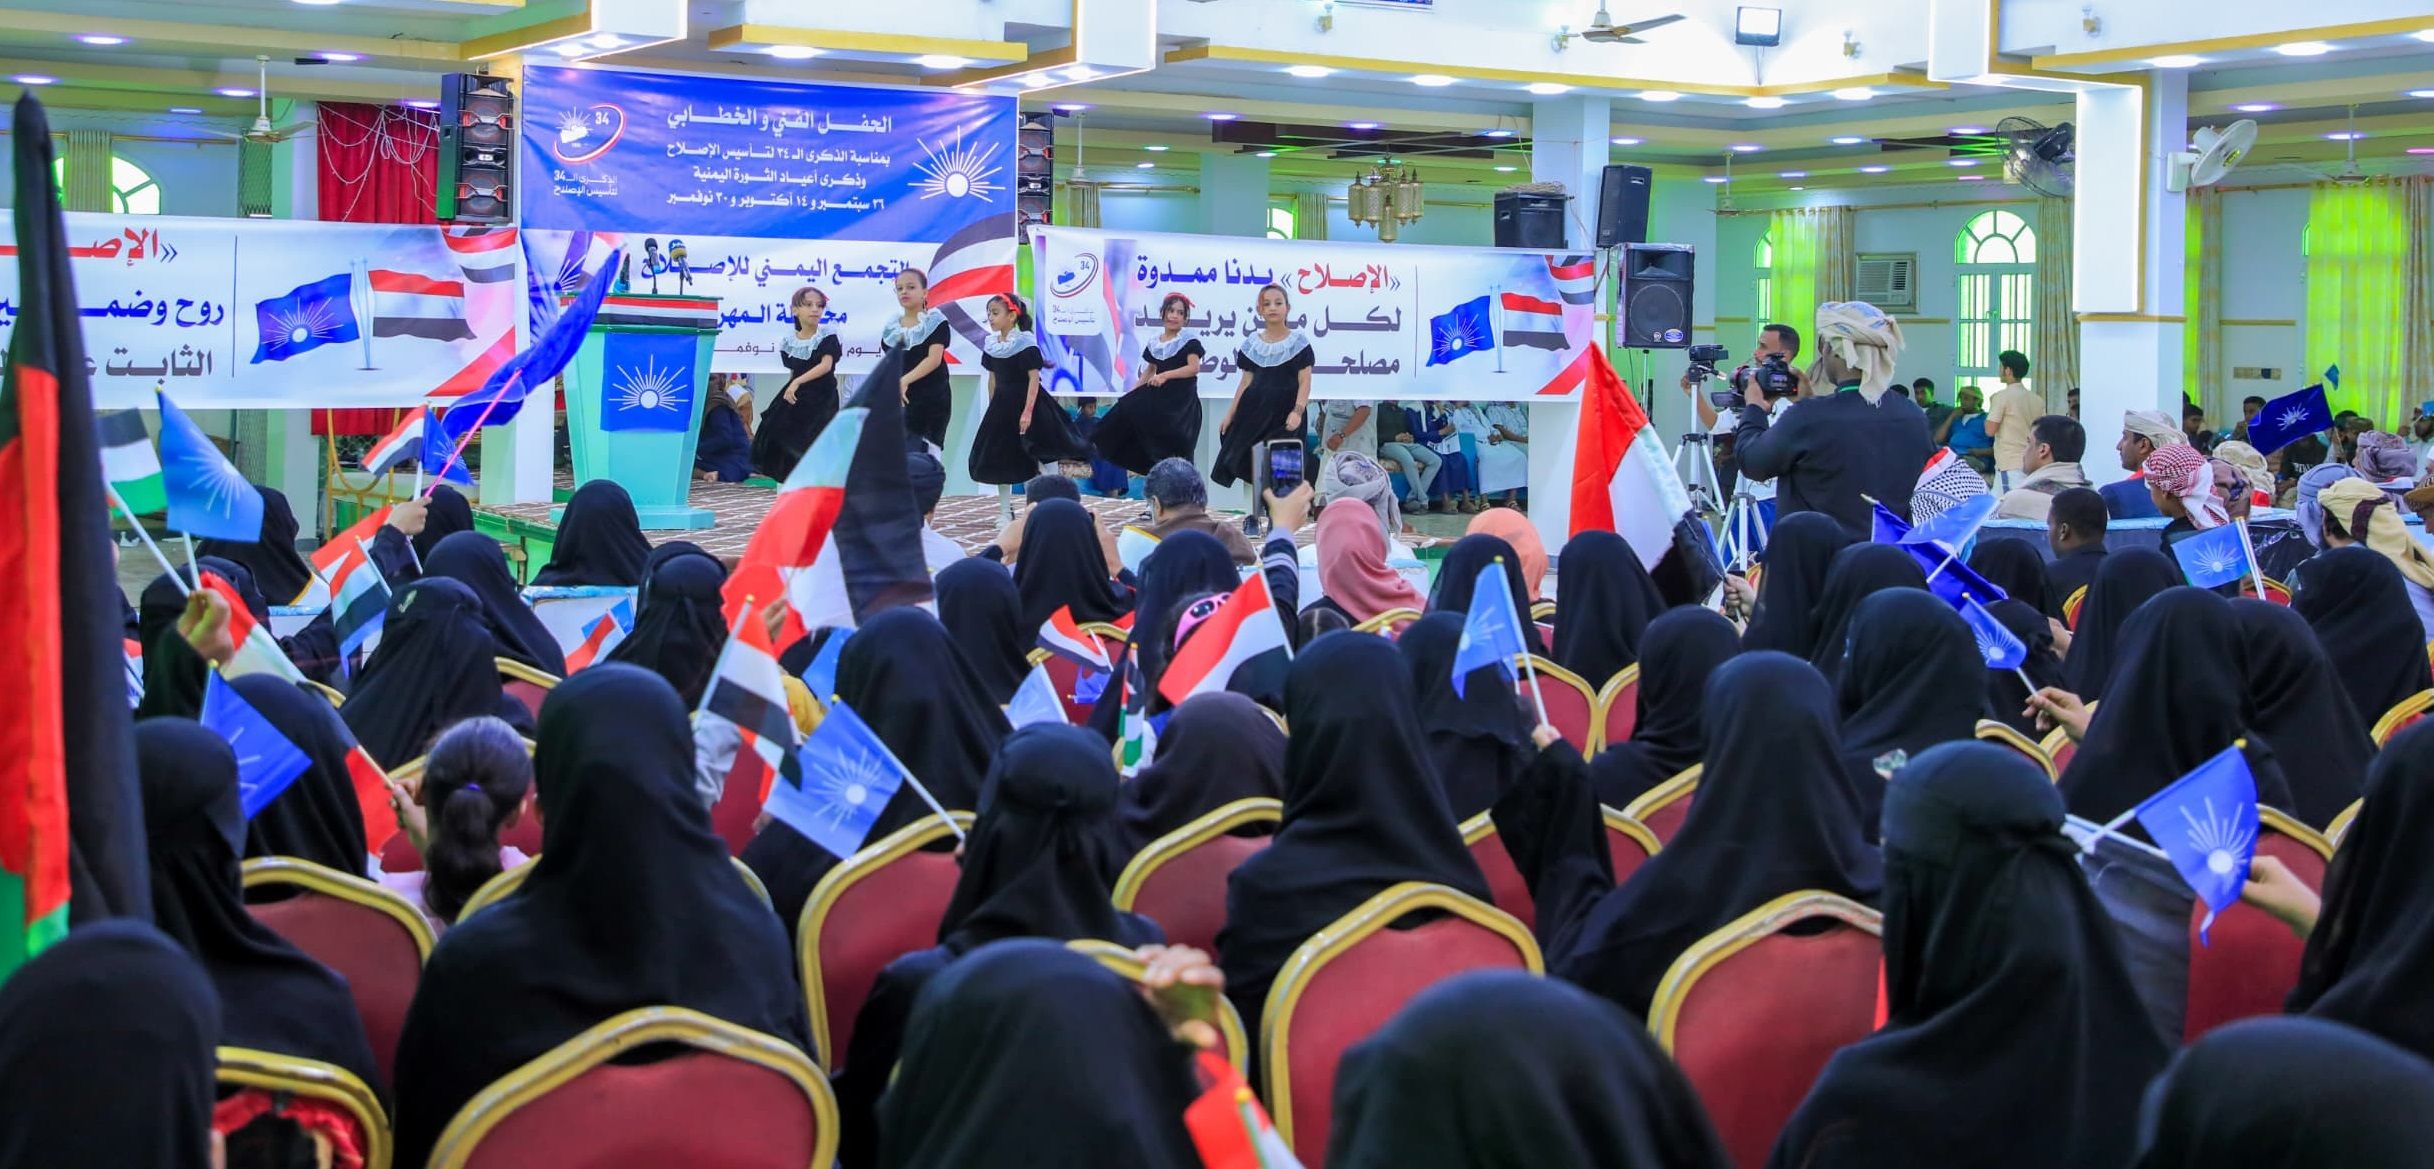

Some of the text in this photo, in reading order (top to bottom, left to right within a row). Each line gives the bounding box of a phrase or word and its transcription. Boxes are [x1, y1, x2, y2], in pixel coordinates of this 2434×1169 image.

[595, 111, 609, 125] 34
[667, 104, 892, 137] الحفل الفني و الخطابي
[666, 141, 720, 158] الإصلاح
[722, 143, 775, 160] لتأسيس
[806, 148, 848, 164] الذكرى
[849, 149, 891, 167] بمناسبة
[693, 165, 867, 189] وذكرى أعياد الثورة اليمنية
[666, 189, 714, 206] نوفمبر
[817, 196, 870, 213] سبتمبر
[755, 257, 828, 287] اليمني
[0, 289, 224, 328] روح وضمي
[717, 303, 771, 329] المهر
[1313, 304, 1401, 338] لكل
[714, 342, 775, 356] نوفم
[105, 344, 213, 385] الثابت
[1311, 349, 1401, 376] مصلح
